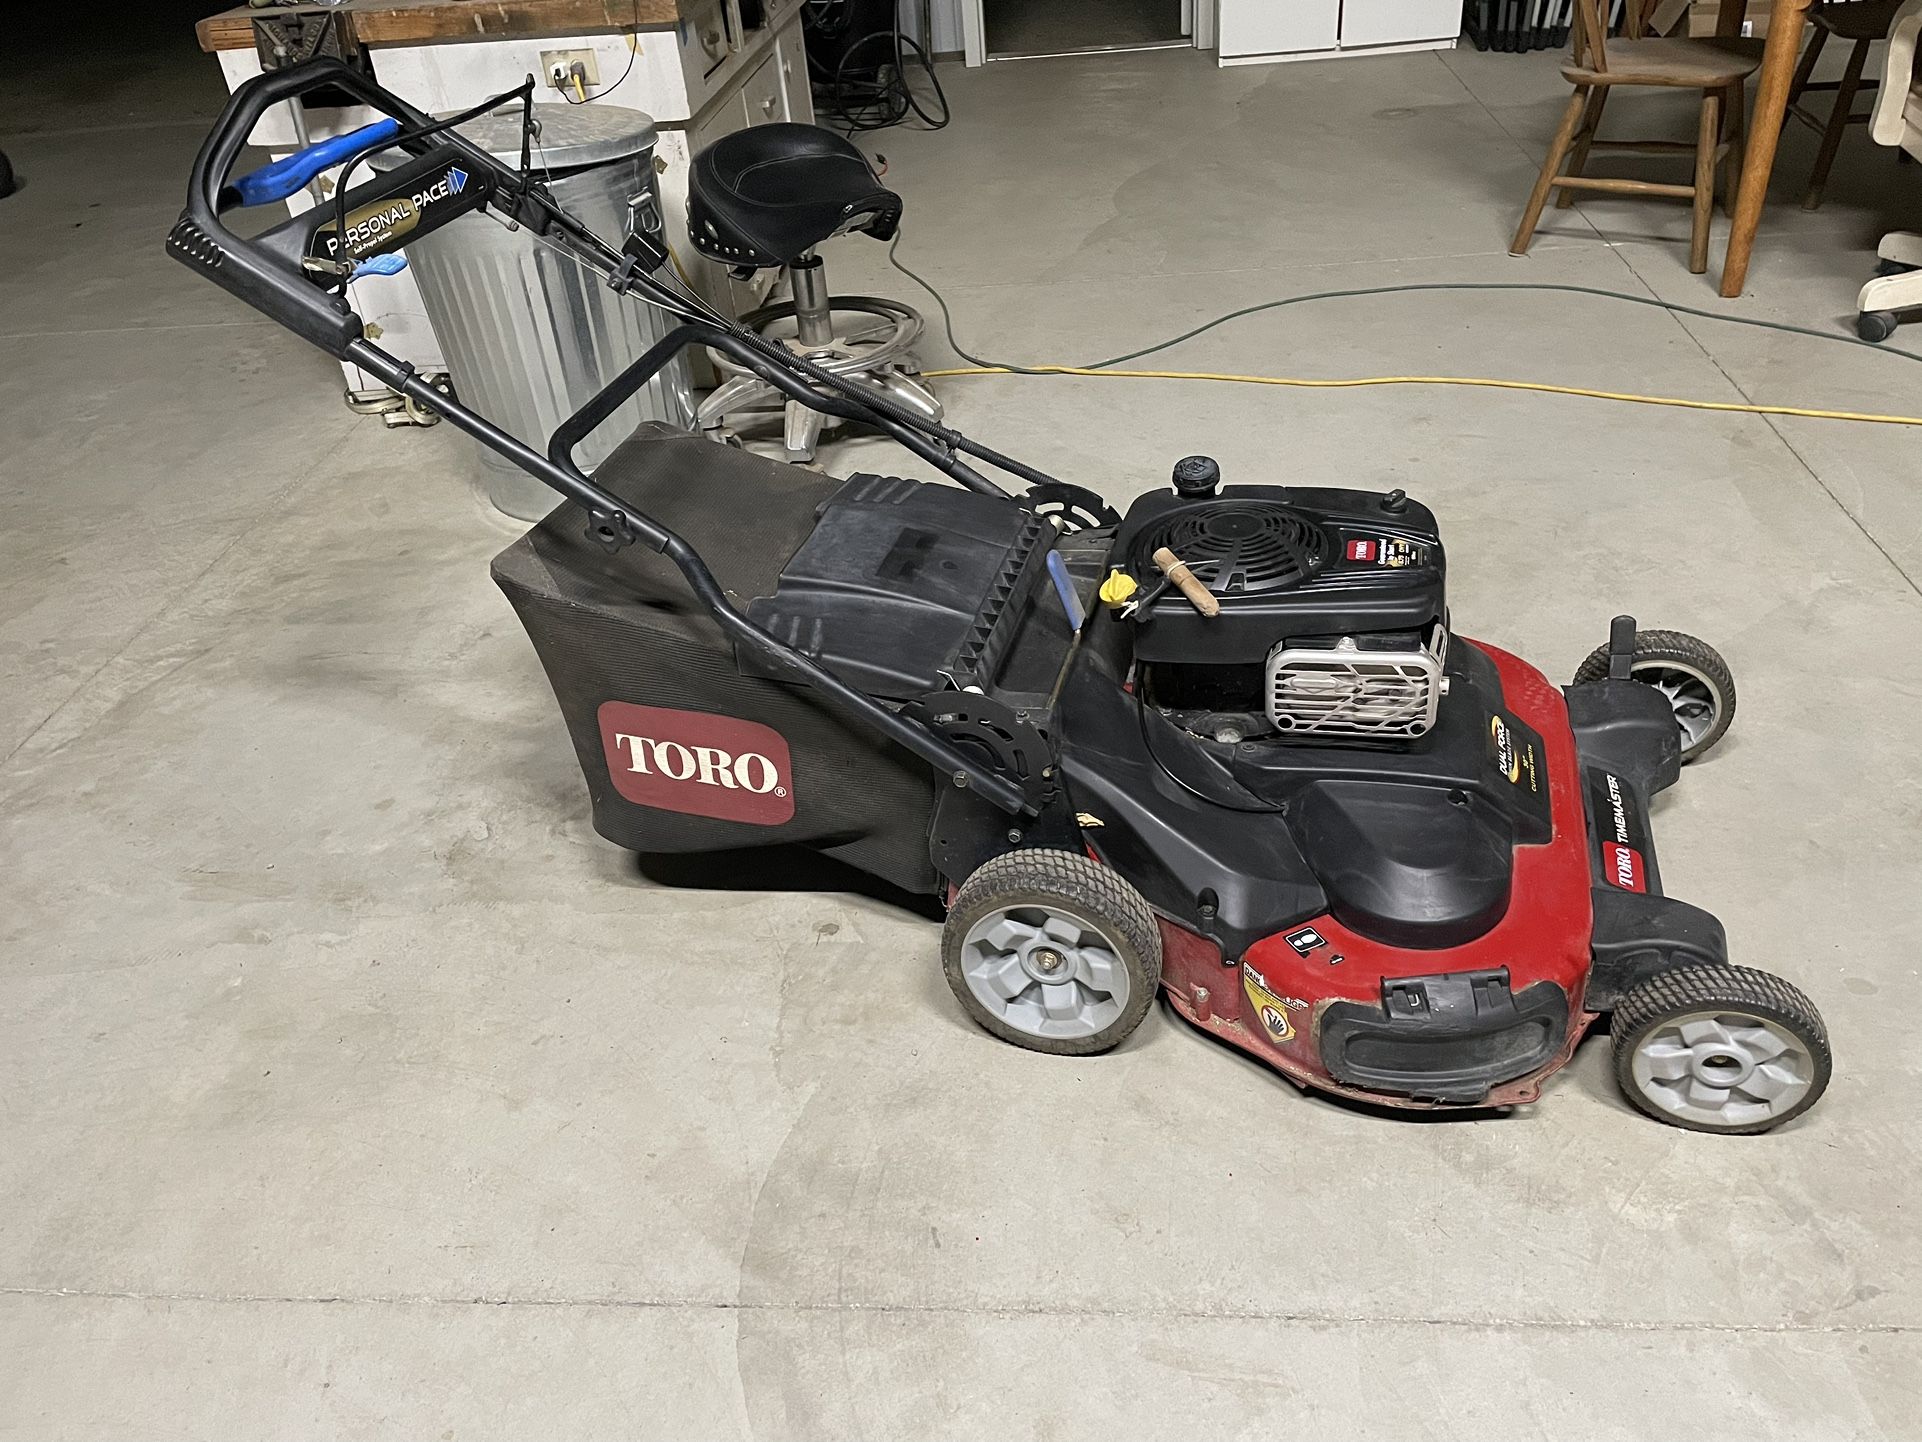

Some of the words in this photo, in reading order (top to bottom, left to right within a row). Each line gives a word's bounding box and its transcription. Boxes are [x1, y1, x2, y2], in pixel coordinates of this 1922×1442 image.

[326, 203, 411, 256] PRSONAL
[412, 179, 449, 211] PACE
[1355, 541, 1368, 559] TORO
[1498, 750, 1508, 775] DUAL
[1606, 773, 1629, 843] TIMEMASTER
[1615, 847, 1634, 887] TORO
